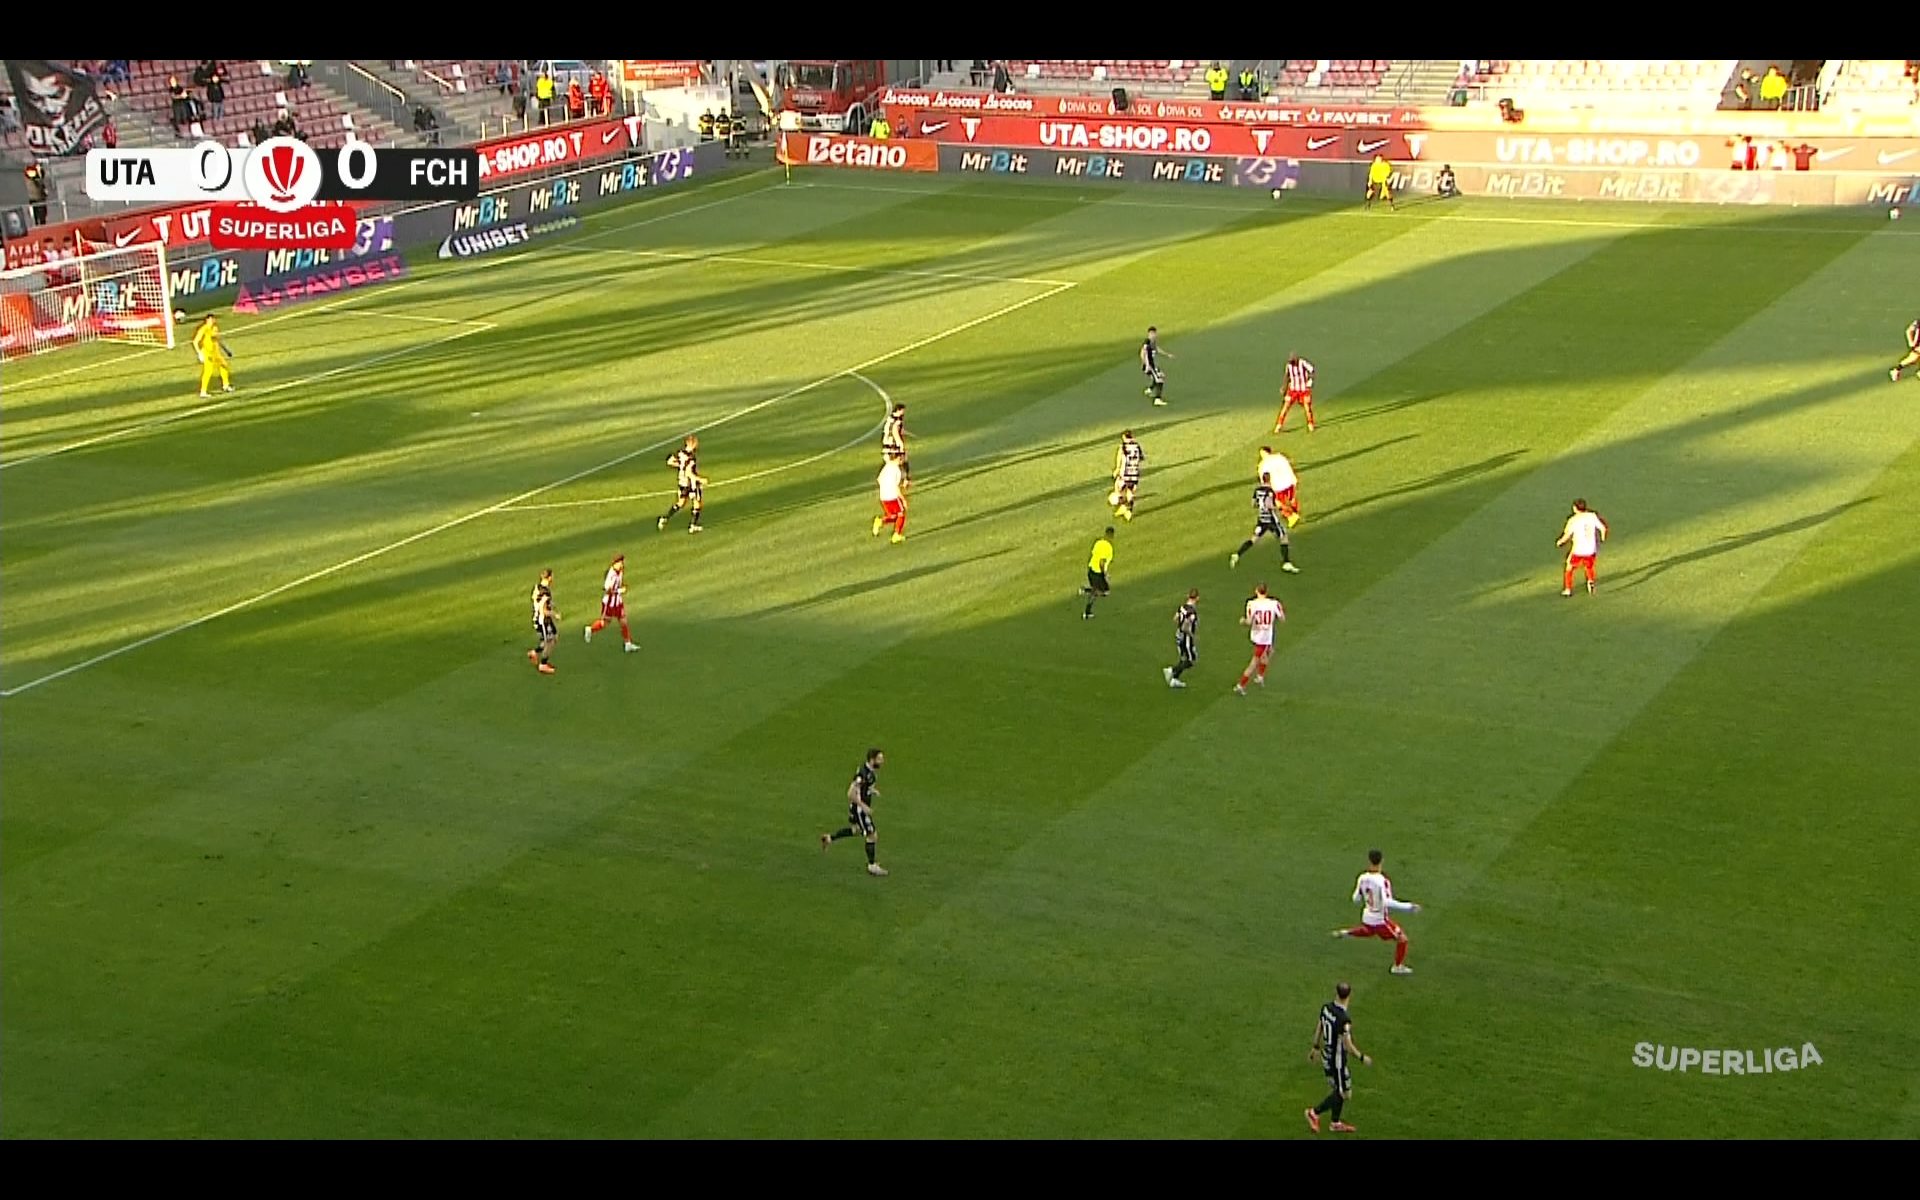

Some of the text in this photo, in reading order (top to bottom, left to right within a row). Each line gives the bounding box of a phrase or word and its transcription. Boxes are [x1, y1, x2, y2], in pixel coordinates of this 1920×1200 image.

[1235, 108, 1302, 122] FAVBET
[1323, 111, 1392, 125] FAVBET
[1039, 122, 1211, 151] UTA-SHOP.RO
[1495, 136, 1700, 166] UTA-SHOP.RO
[478, 136, 567, 178] A-SHOP.RO
[808, 137, 906, 168] Betano
[453, 223, 531, 257] UNIBET
[284, 256, 401, 300] FAVBET
[1254, 609, 1272, 625] 30
